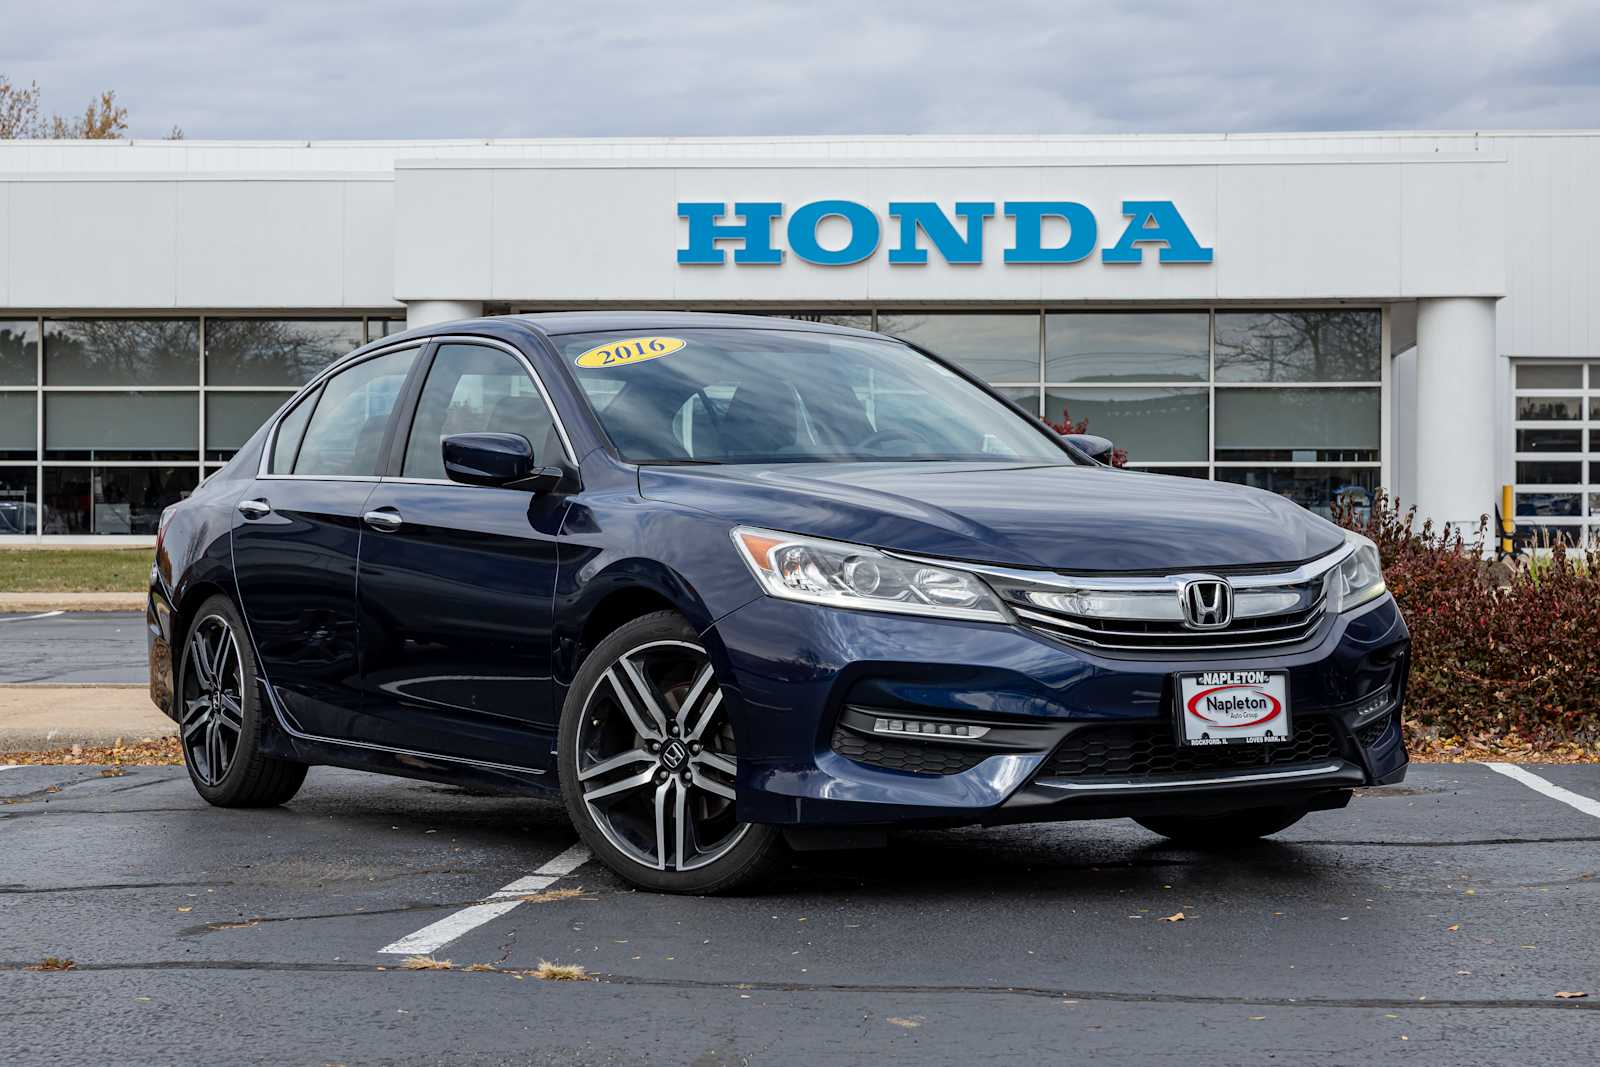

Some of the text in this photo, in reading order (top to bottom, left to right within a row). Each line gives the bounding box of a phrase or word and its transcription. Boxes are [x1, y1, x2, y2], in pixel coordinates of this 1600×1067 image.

[676, 199, 1214, 266] HONDA
[597, 339, 665, 364] 2016
[1203, 671, 1265, 685] NAPLETON
[1206, 695, 1267, 713] Napleton
